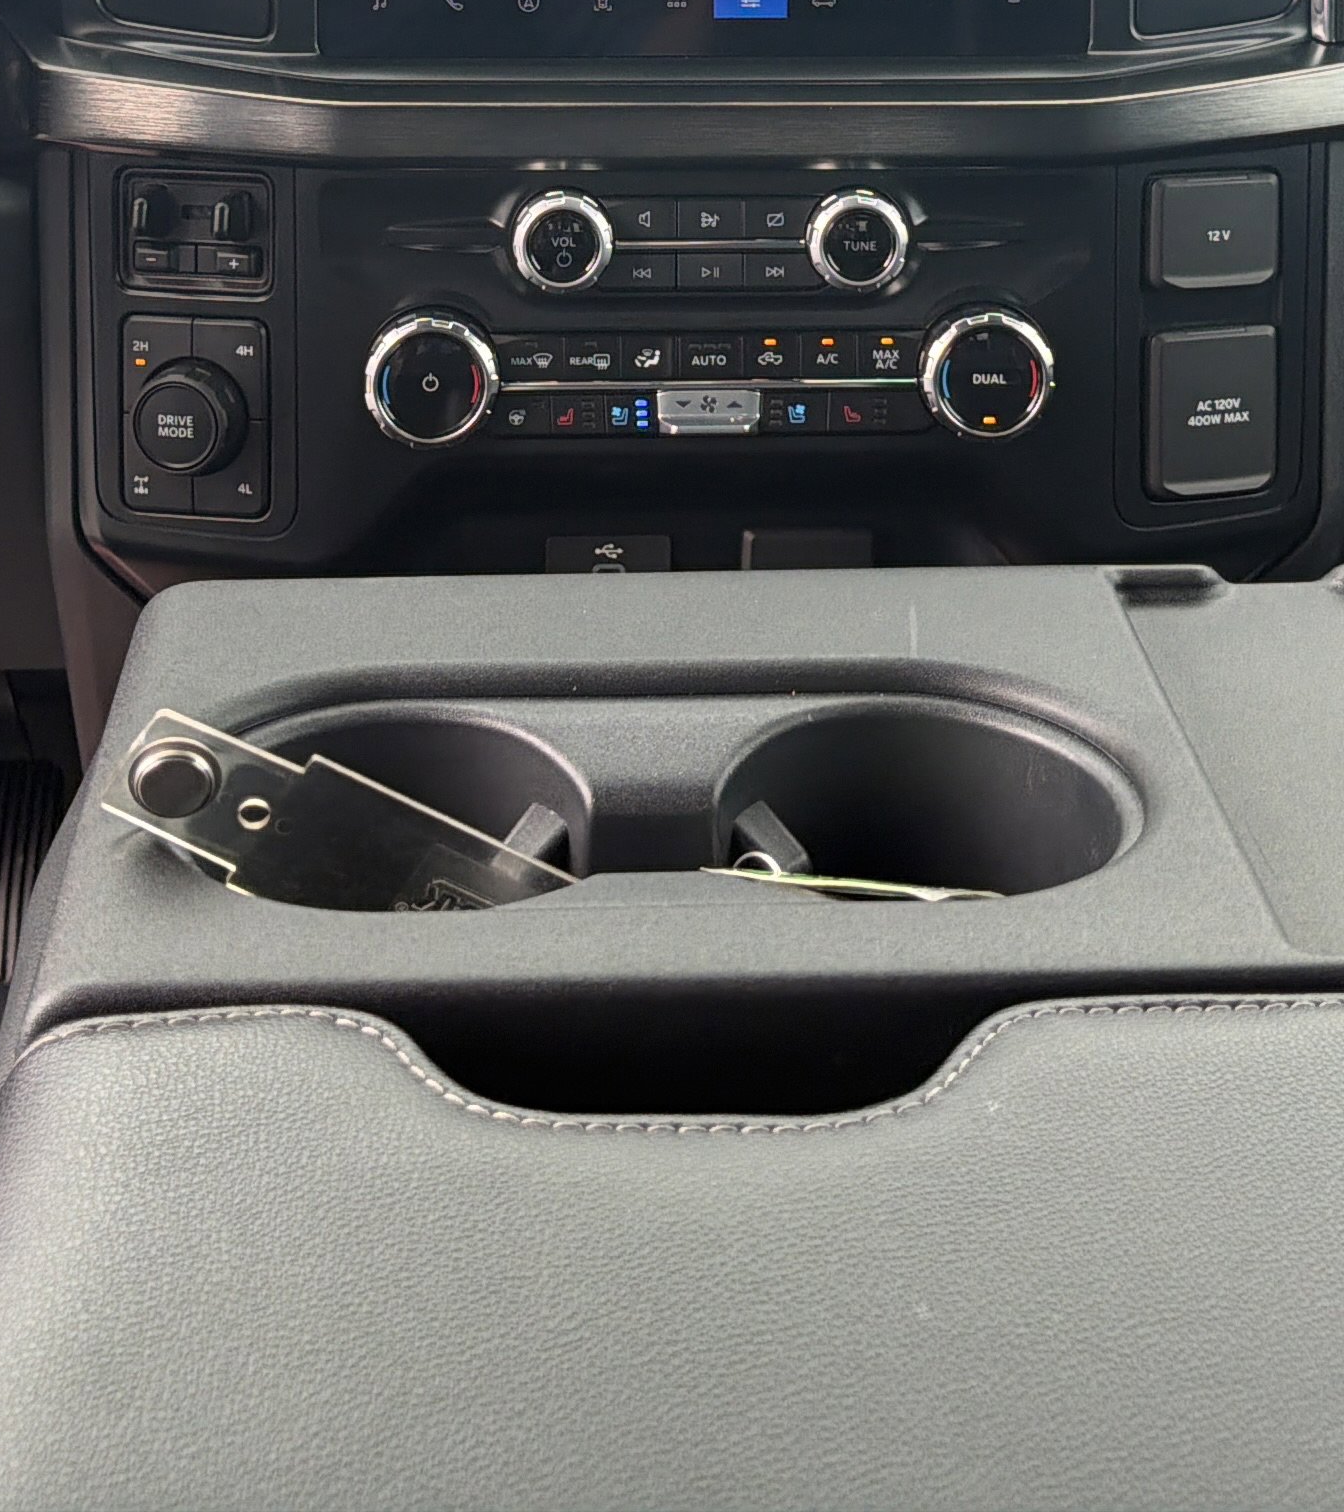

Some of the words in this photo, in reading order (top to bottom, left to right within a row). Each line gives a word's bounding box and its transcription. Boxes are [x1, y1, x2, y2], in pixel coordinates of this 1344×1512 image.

[1207, 230, 1221, 242] 12
[1221, 229, 1232, 242] V
[551, 236, 577, 249] VOL
[843, 240, 878, 253] TUNE
[132, 341, 150, 352] 2H
[235, 345, 254, 357] 4H
[691, 355, 728, 366] AUTO
[816, 353, 839, 365] A/C
[872, 349, 900, 360] MAX
[510, 357, 533, 366] MAX
[569, 356, 594, 366] REAR
[875, 359, 898, 370] A/C
[971, 373, 1007, 386] DUAL
[1196, 399, 1213, 412] AC
[1214, 397, 1242, 411] 120V
[157, 414, 195, 427] DRIVE
[1187, 413, 1222, 427] 400W
[1223, 410, 1251, 424] MAX
[157, 426, 195, 439] MODE
[237, 484, 253, 495] 4L
